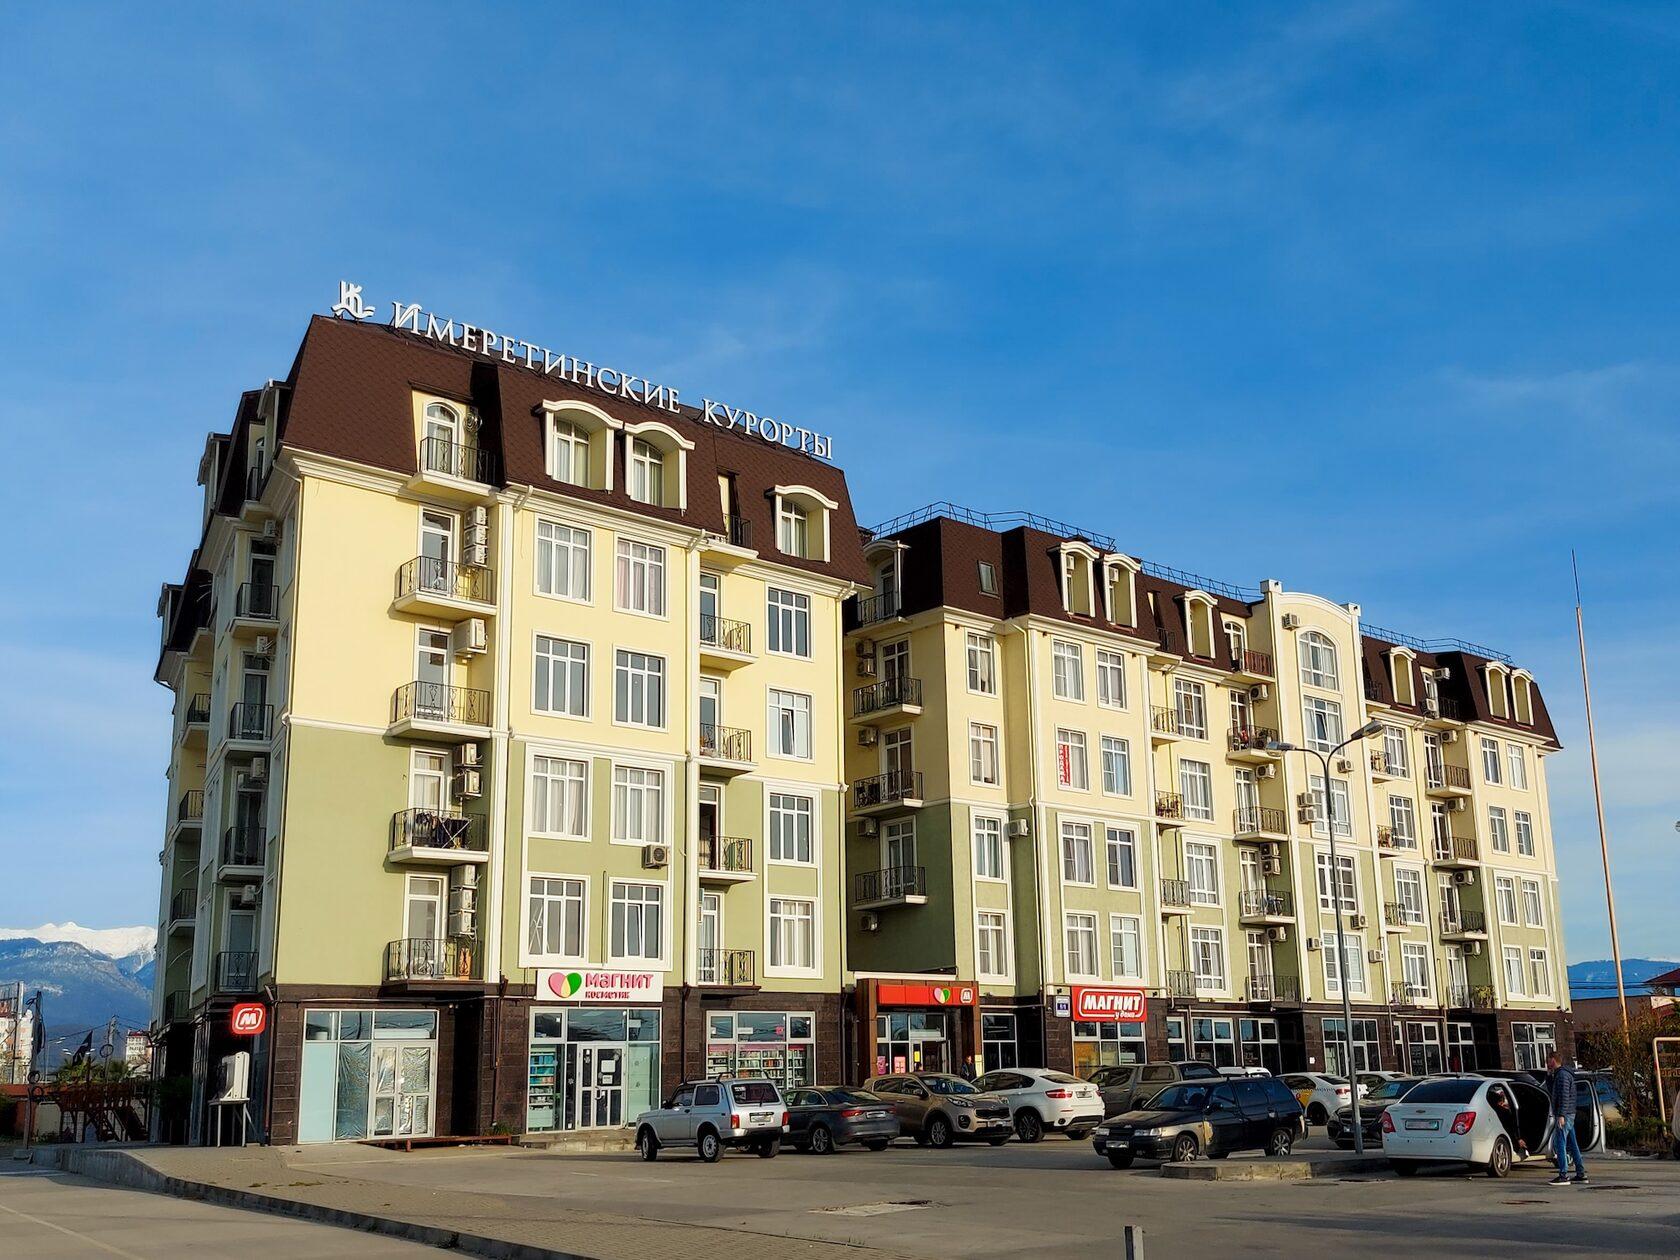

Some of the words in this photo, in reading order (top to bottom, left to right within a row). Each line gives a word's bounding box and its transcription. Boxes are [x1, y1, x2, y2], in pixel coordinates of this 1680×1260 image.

[392, 301, 681, 414] ИМЕРЕТИНСКИЕ
[701, 398, 833, 460] КУРОРТЫ
[1083, 994, 1141, 1011] МАГНИТ
